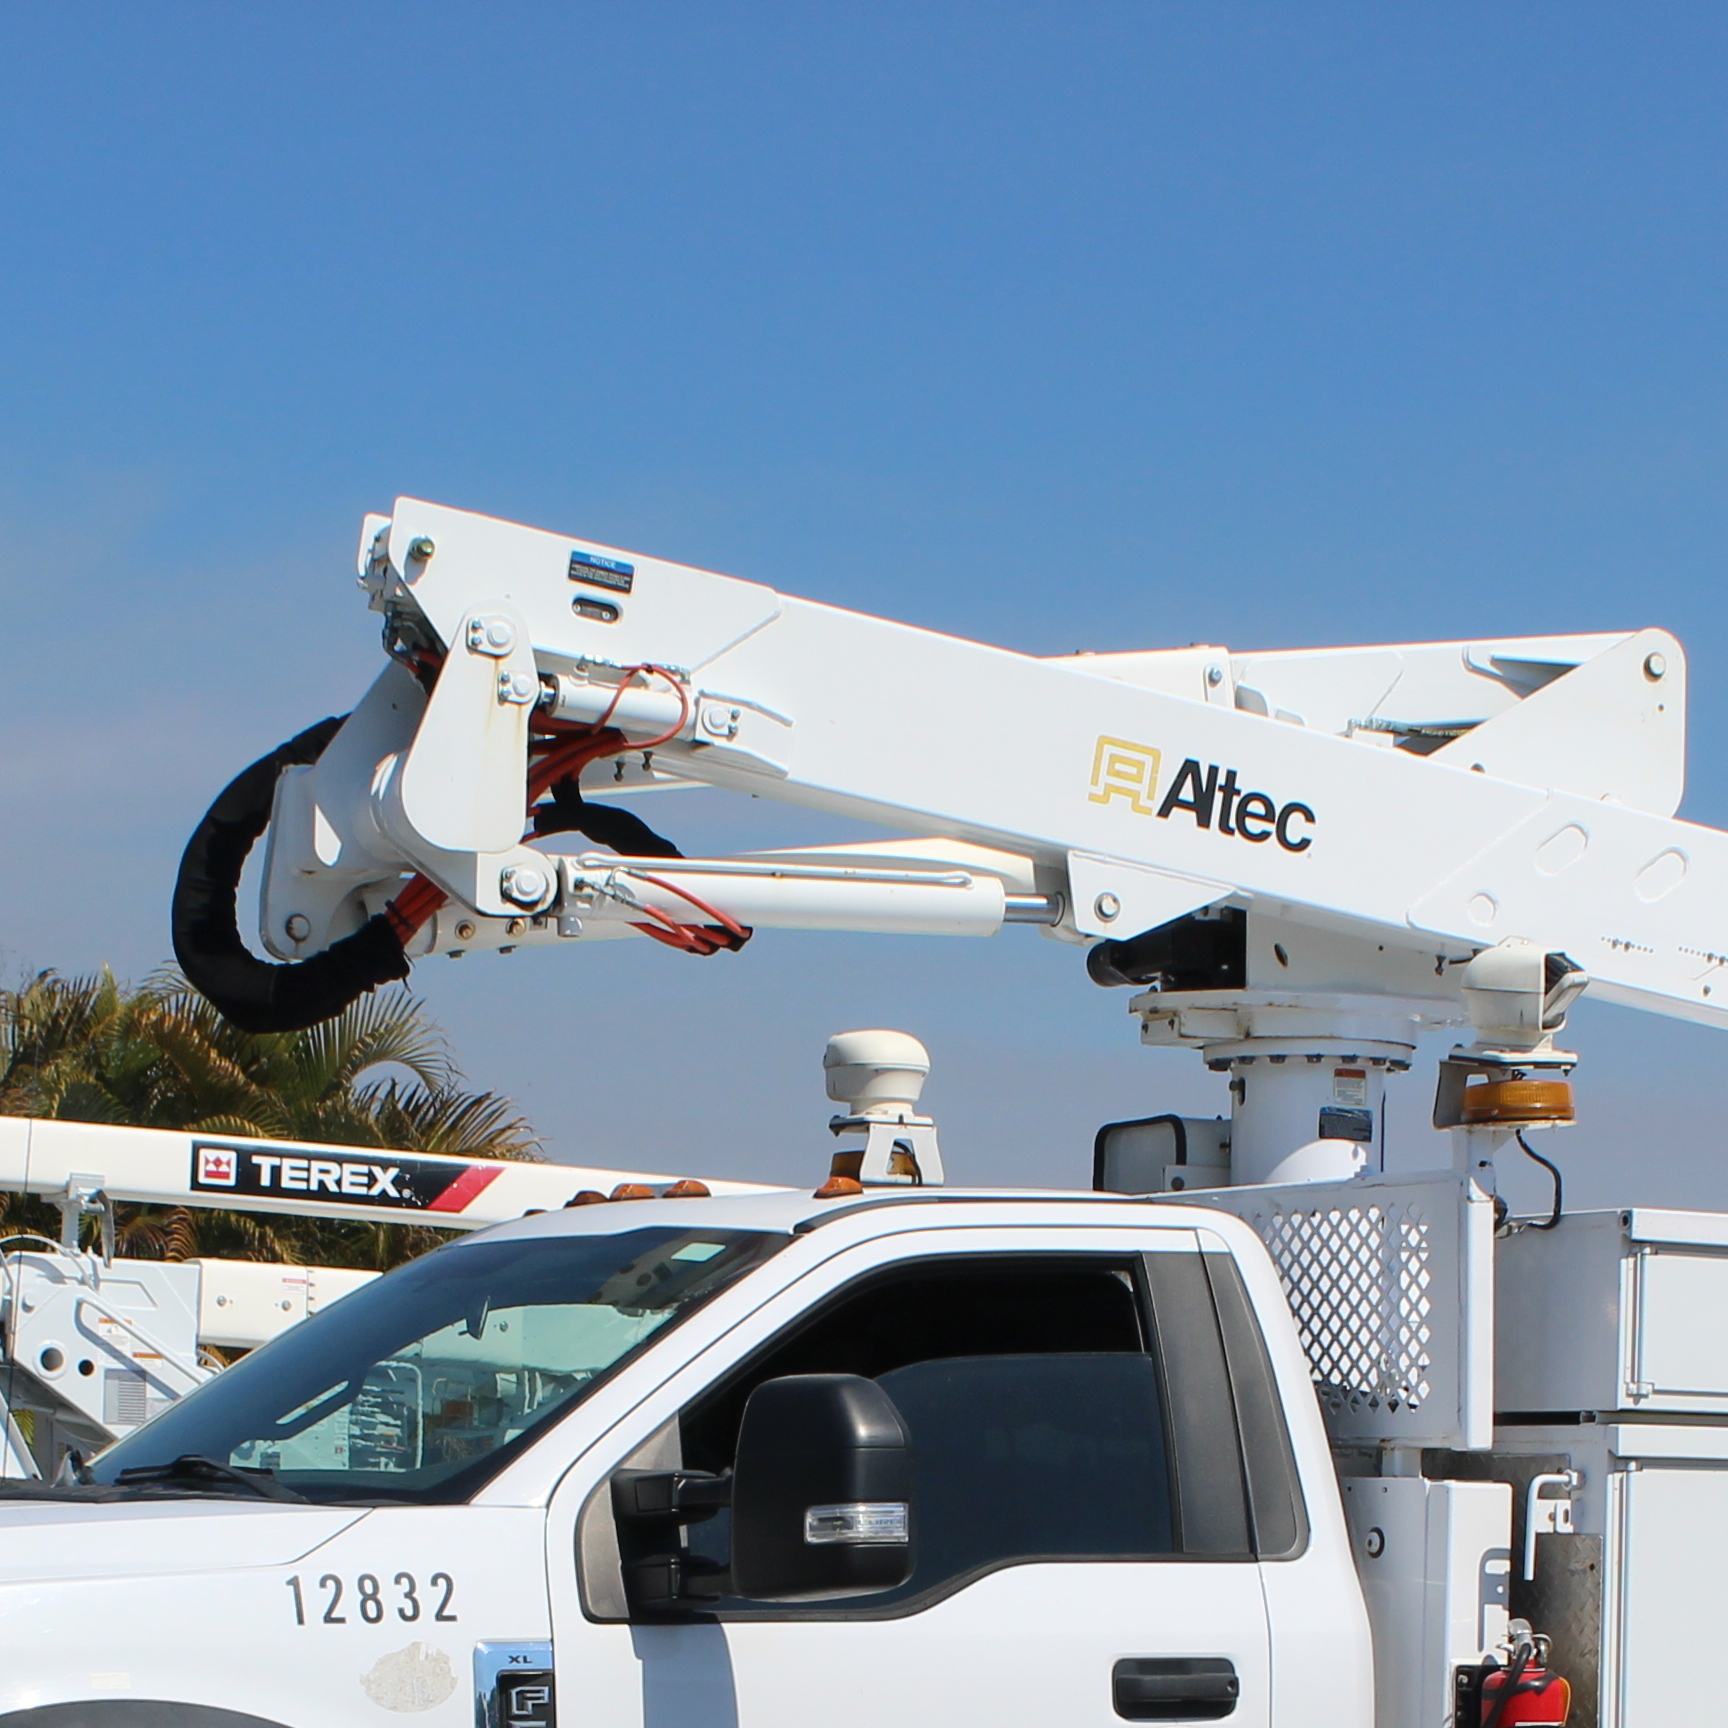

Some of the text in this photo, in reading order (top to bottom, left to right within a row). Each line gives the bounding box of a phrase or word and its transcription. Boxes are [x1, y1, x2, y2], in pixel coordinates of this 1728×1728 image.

[1157, 758, 1316, 853] Altec
[251, 1155, 401, 1198] TEREX
[286, 1571, 458, 1626] 12832
[508, 1655, 533, 1664] XL
